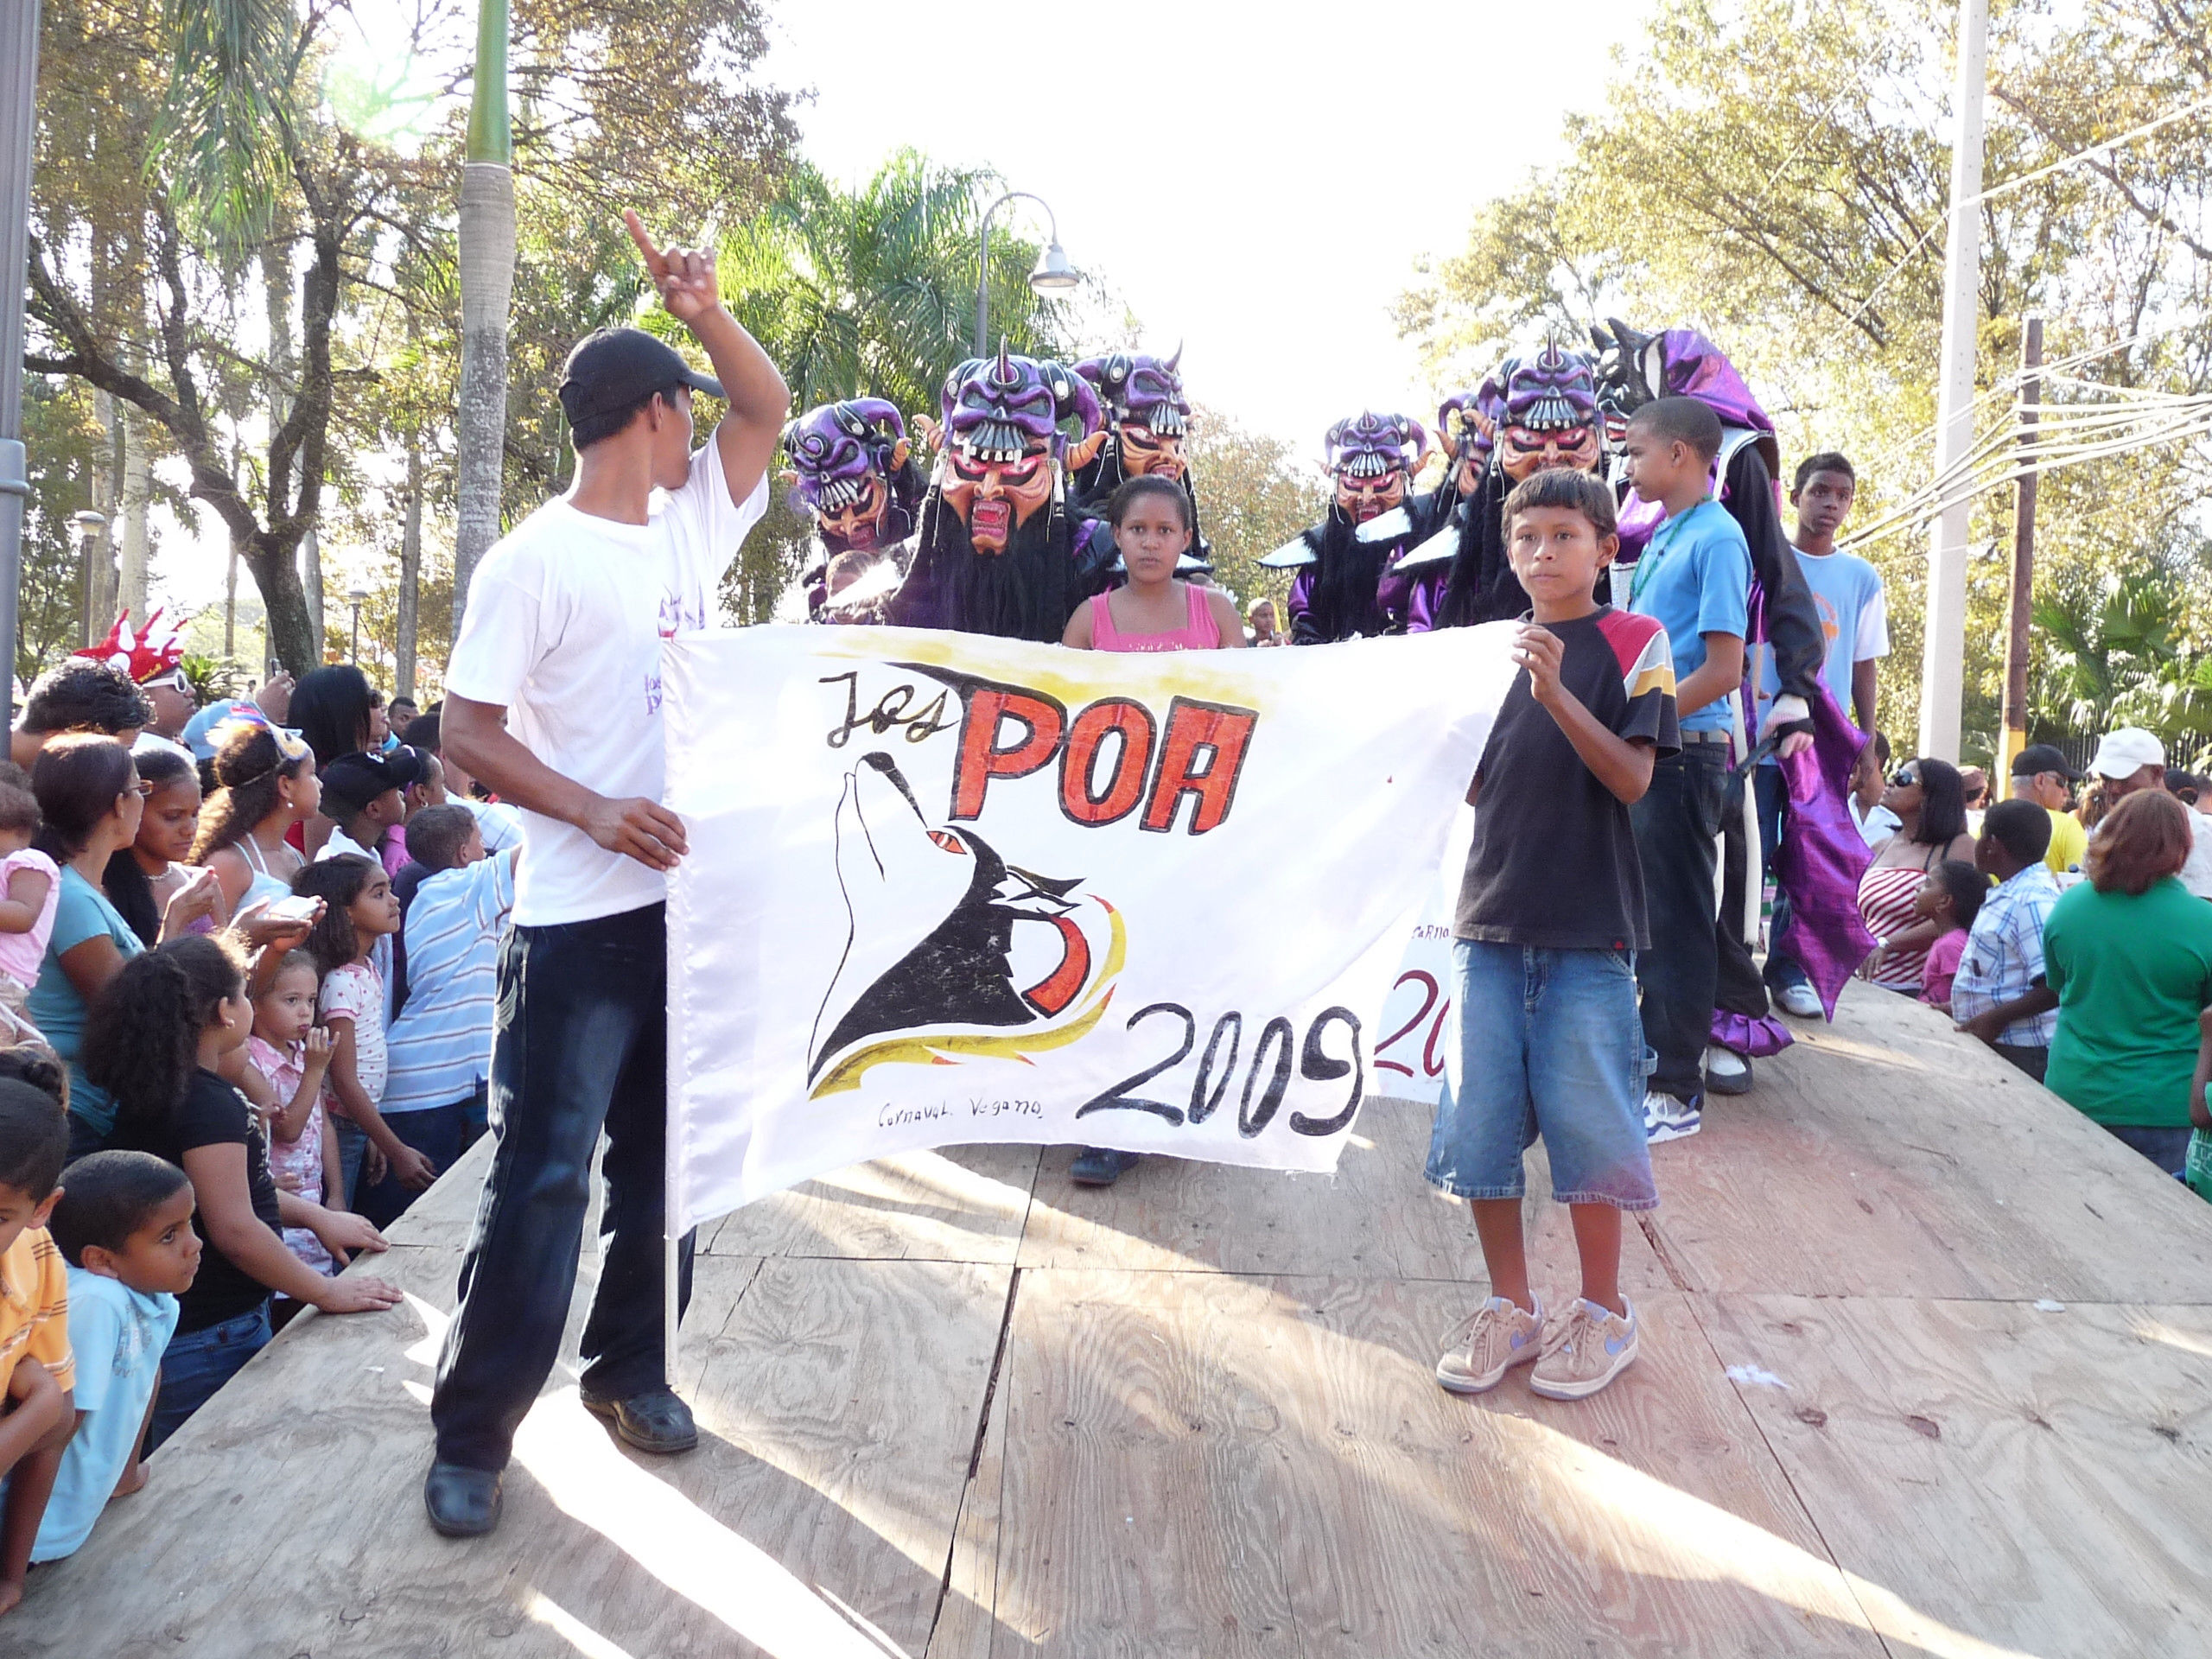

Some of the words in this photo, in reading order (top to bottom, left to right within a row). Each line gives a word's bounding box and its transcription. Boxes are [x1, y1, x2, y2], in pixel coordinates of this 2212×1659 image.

[948, 680, 1260, 836] POA
[1075, 1001, 1363, 1140] 2009
[1373, 969, 1451, 1077] 20
